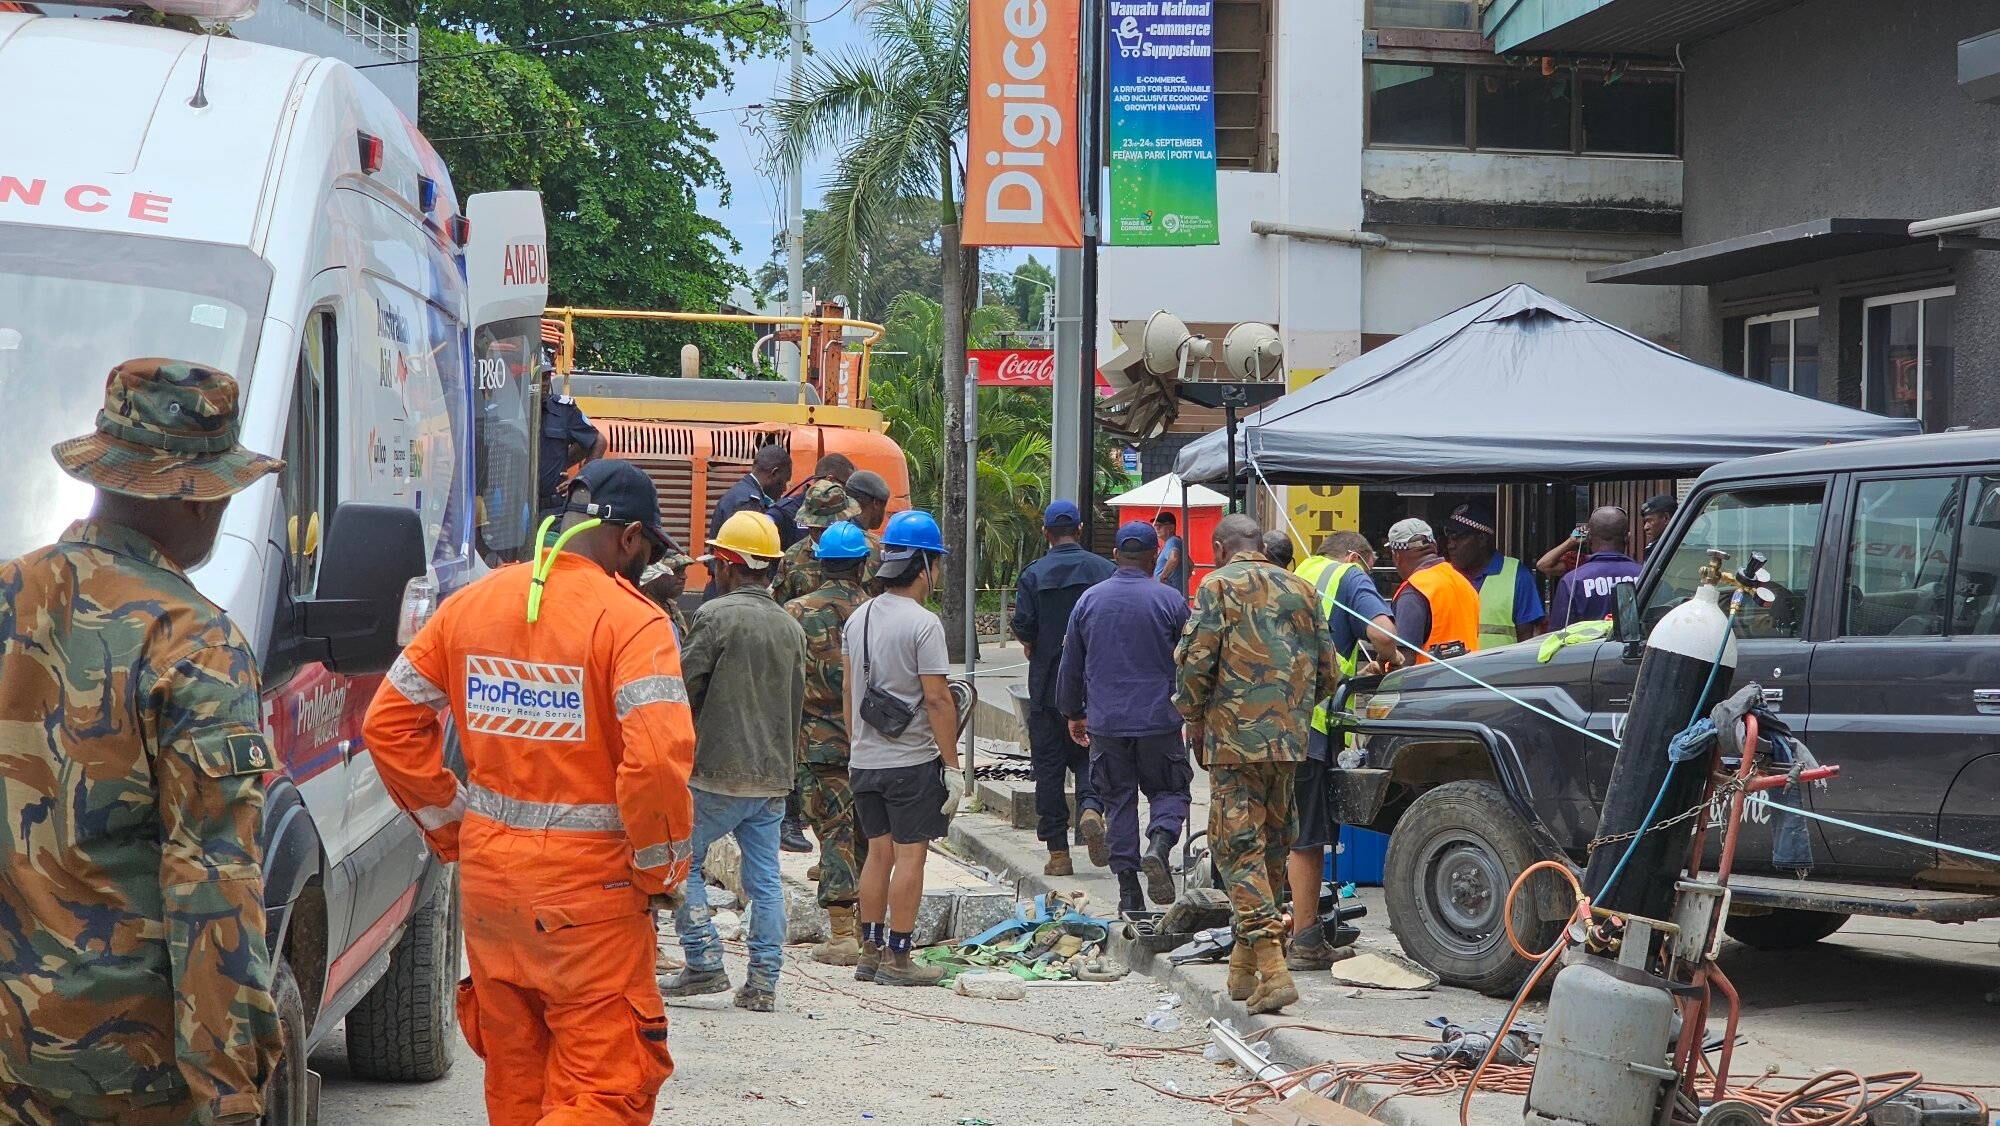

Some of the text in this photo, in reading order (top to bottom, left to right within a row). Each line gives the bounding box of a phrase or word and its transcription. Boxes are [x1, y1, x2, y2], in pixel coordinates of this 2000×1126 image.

[1111, 0, 1210, 16] Vanuatu National
[1142, 40, 1211, 60] Symposium
[1136, 76, 1188, 84] E-COMMERCE,
[1163, 85, 1211, 93] SUSTAINABLE
[1156, 139, 1202, 147] SEPTEMBER
[1145, 151, 1165, 160] PARK
[1171, 151, 1192, 159] PORT
[1194, 151, 1213, 159] VILA
[0, 176, 173, 224] NCE
[503, 244, 548, 286] AMBU
[478, 358, 506, 390] P&O
[998, 353, 1054, 381] Coca-C
[468, 676, 581, 710] ProRescue
[297, 677, 347, 736] ProMedical
[467, 702, 512, 715] Emergency
[545, 710, 583, 720] Service
